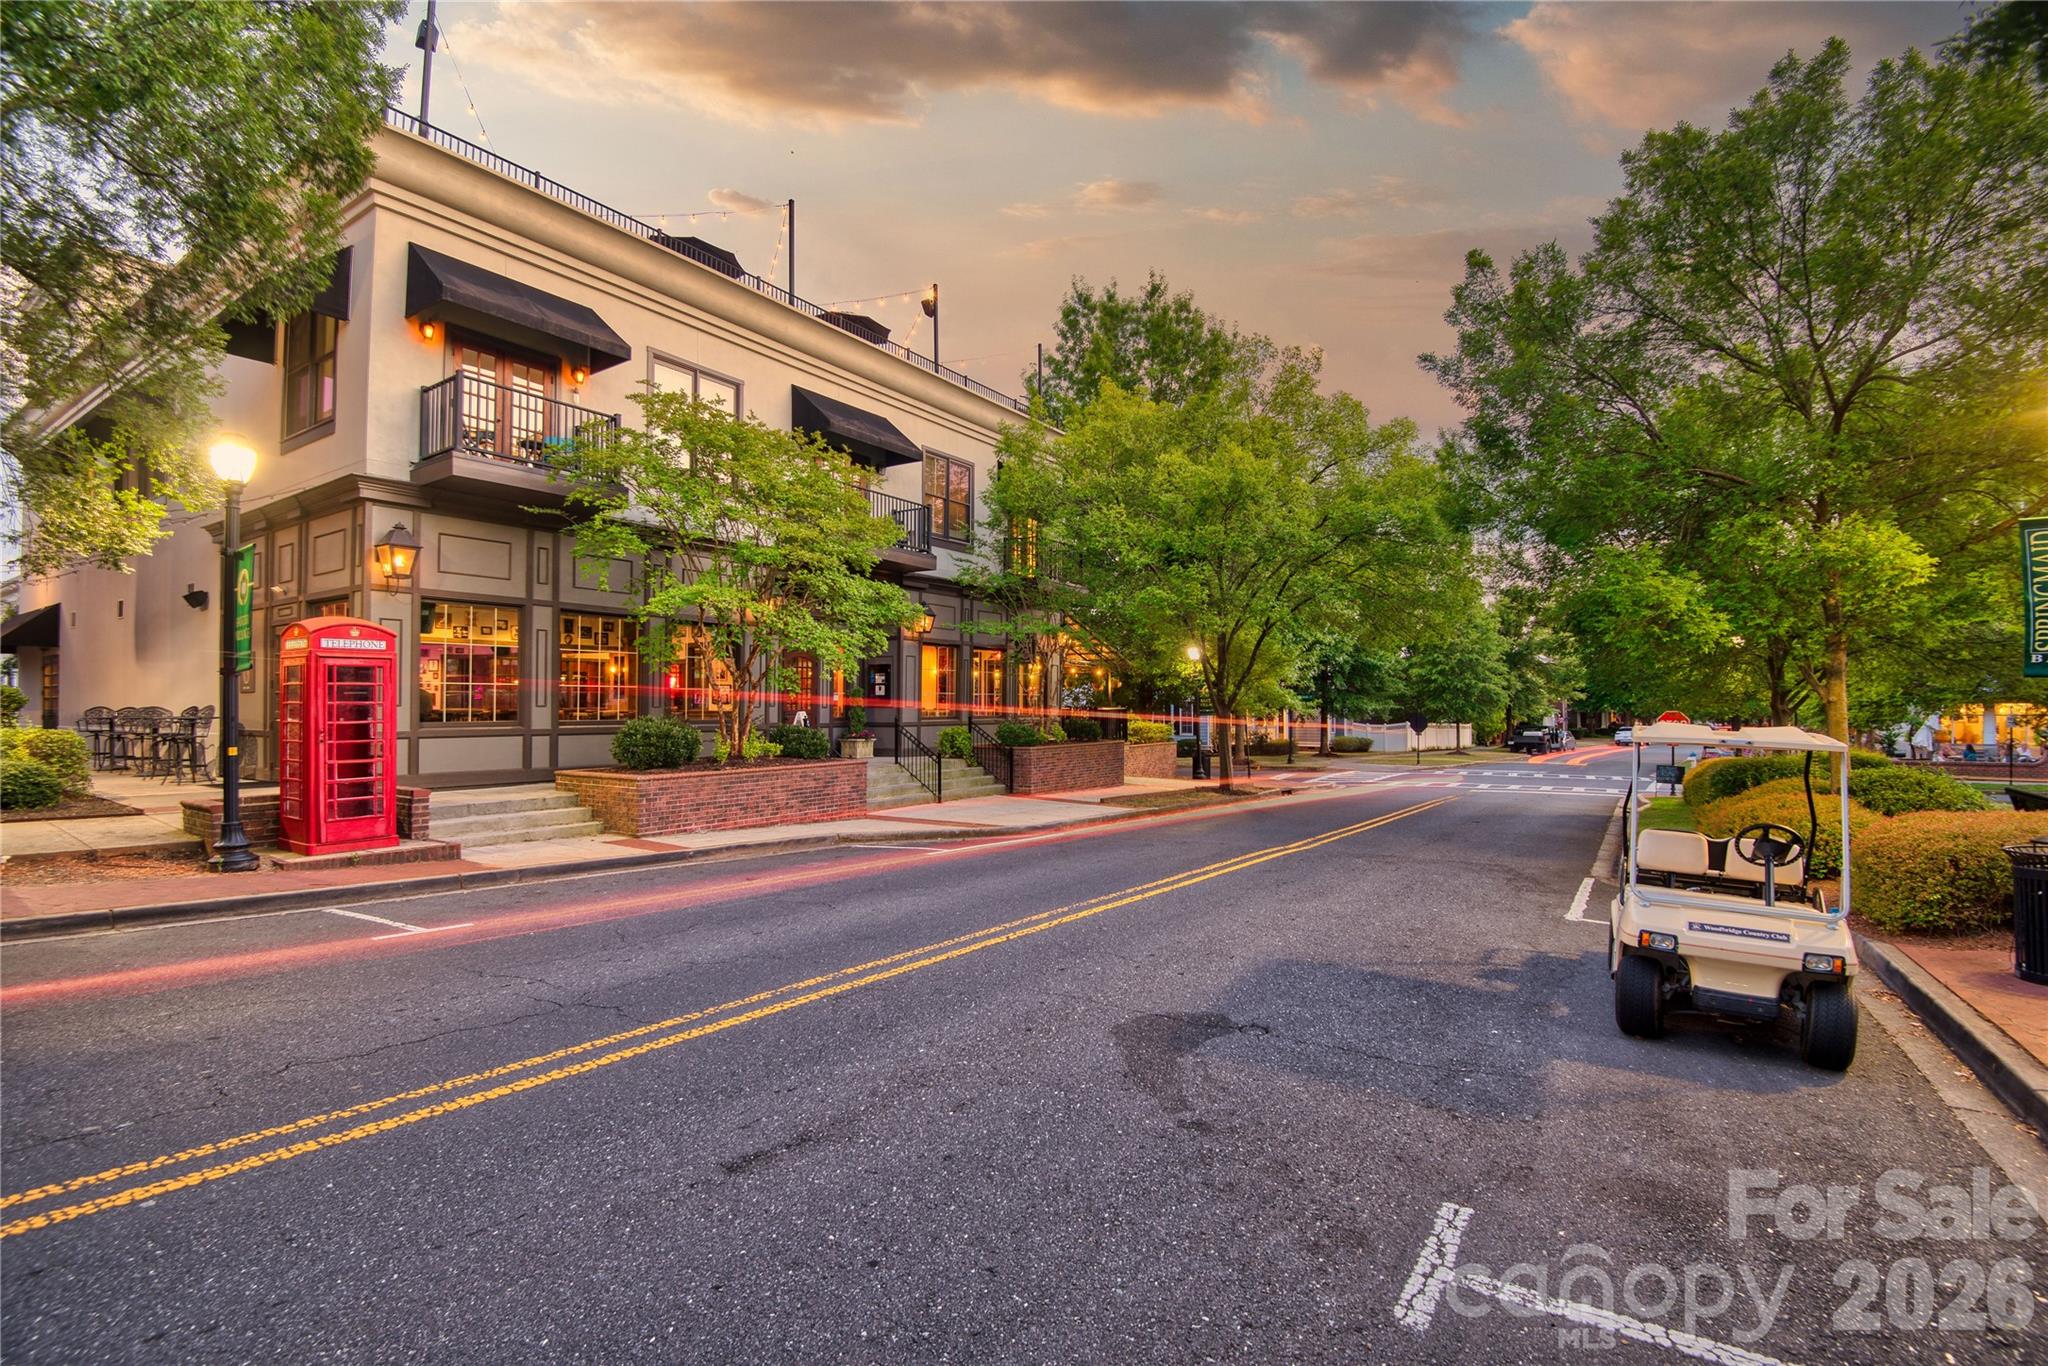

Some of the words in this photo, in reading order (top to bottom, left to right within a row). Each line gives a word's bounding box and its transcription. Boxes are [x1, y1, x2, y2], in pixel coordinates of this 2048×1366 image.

[323, 639, 385, 649] TELEPHONE
[1703, 924, 1742, 936] Woodbridge
[1743, 929, 1770, 939] Country
[1771, 933, 1788, 941] Club
